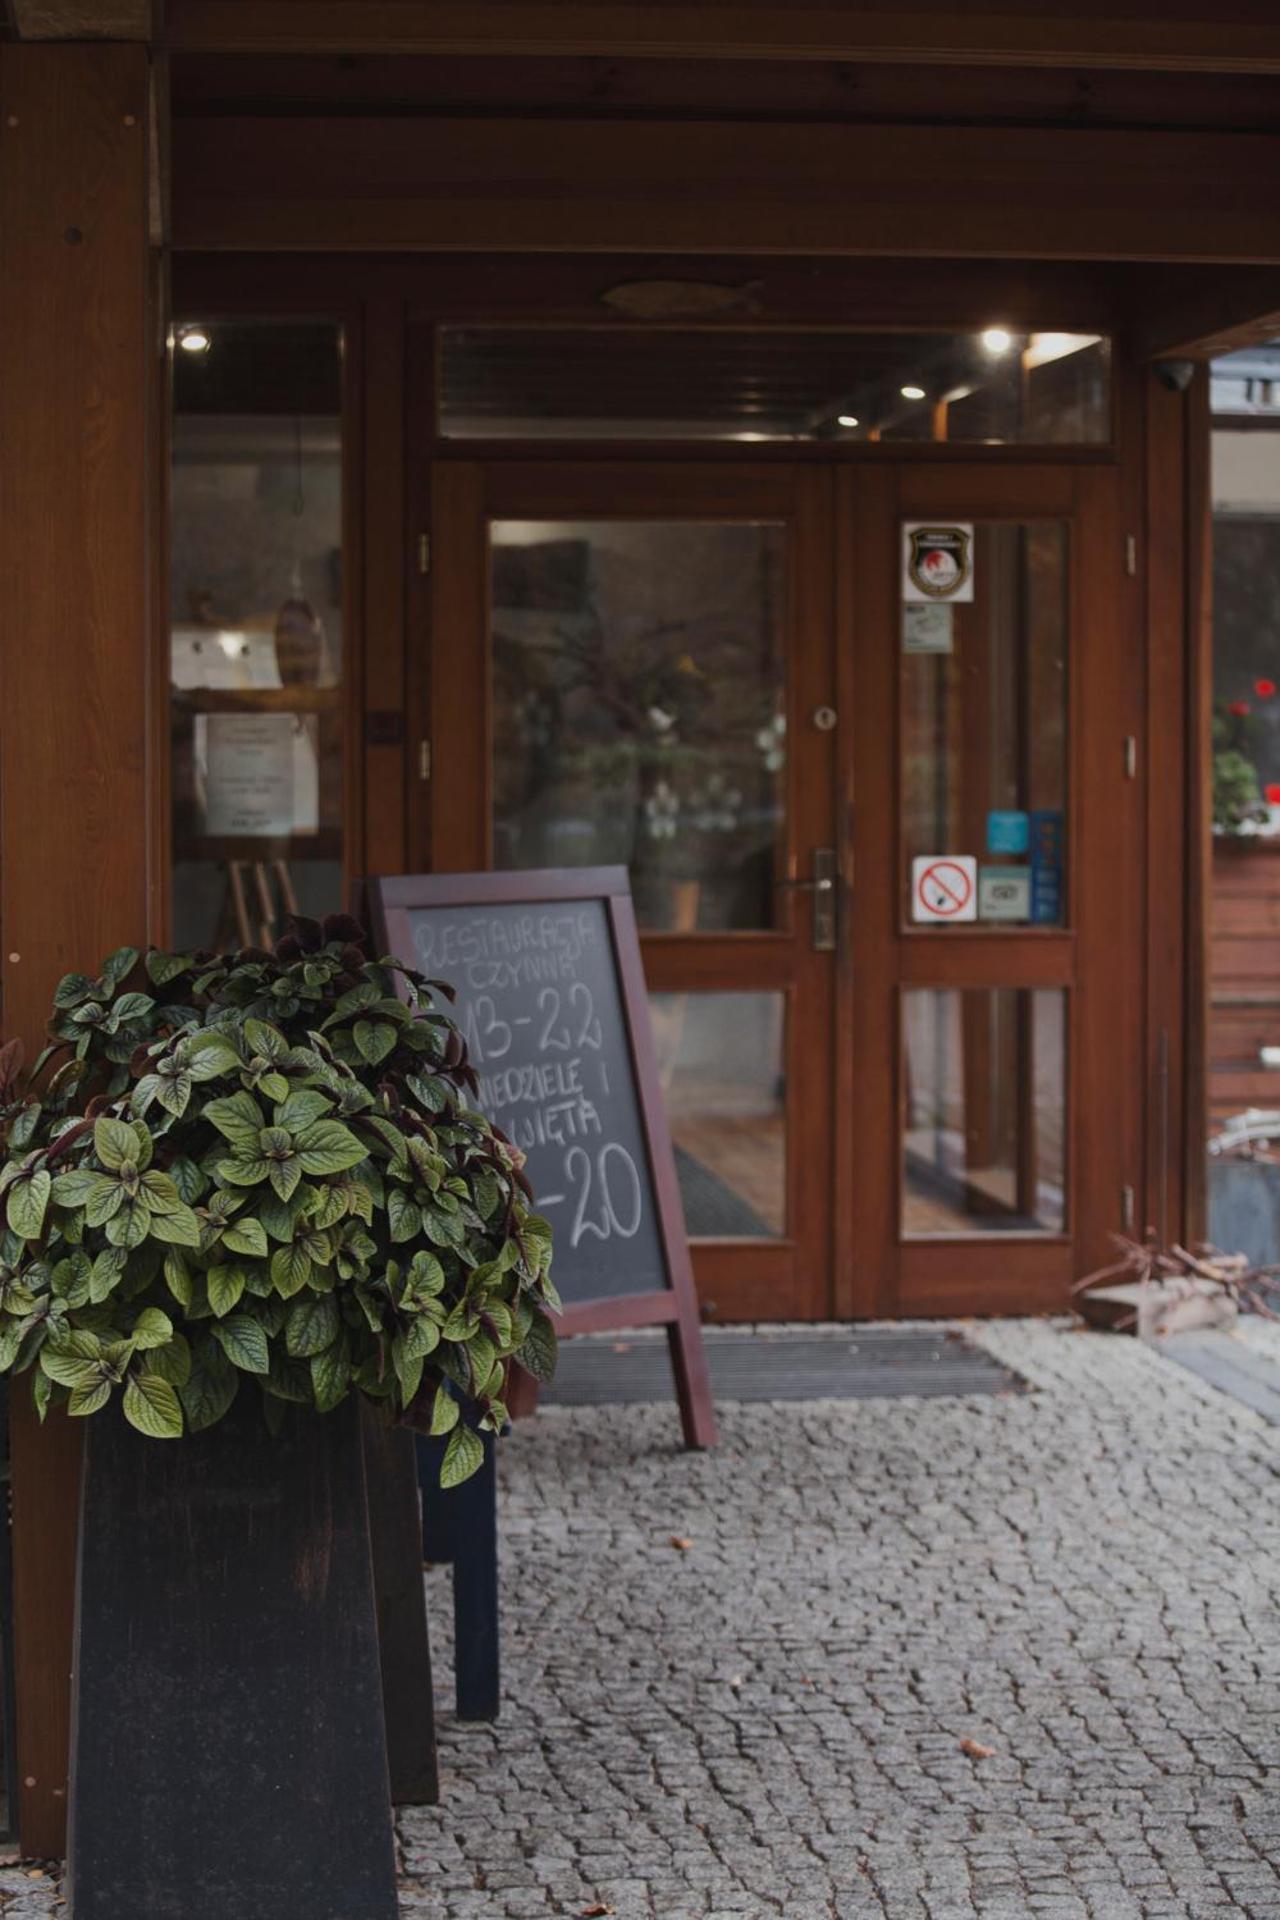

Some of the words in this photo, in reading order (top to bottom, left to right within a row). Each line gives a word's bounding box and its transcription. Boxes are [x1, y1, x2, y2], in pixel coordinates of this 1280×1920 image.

[468, 950, 578, 990] CZYNNA
[466, 982, 603, 1064] 13-22
[489, 1094, 603, 1148] WIĘTA
